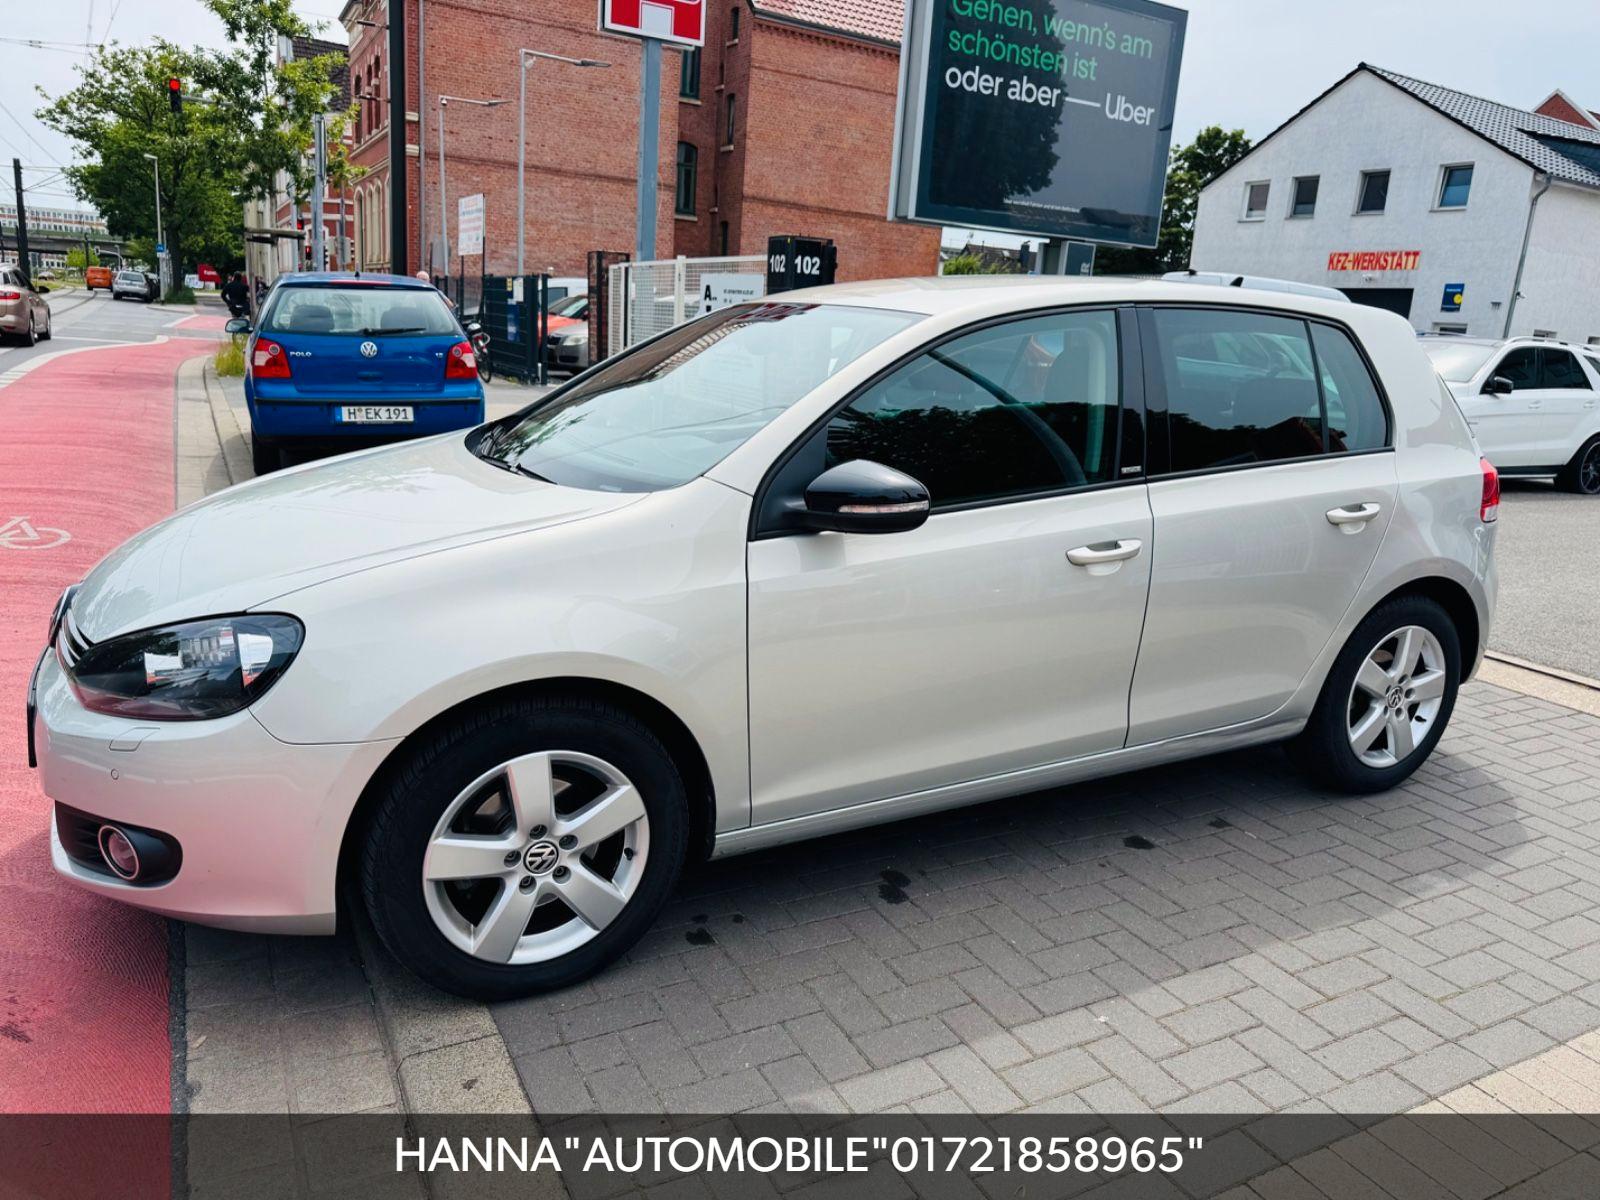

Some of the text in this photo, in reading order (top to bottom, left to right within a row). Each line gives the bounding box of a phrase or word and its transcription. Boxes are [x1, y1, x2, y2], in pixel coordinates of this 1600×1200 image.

[952, 0, 1038, 37] Gehen,
[1120, 34, 1153, 59] am
[948, 29, 1098, 81] schönsten ist
[945, 66, 1004, 97] oder
[1007, 75, 1061, 107] aber
[1105, 93, 1155, 126] Uber
[769, 254, 786, 273] 102
[794, 255, 821, 275] 102
[1327, 250, 1421, 271] KFZ-WERKSTATT
[347, 407, 409, 420] H EK 191
